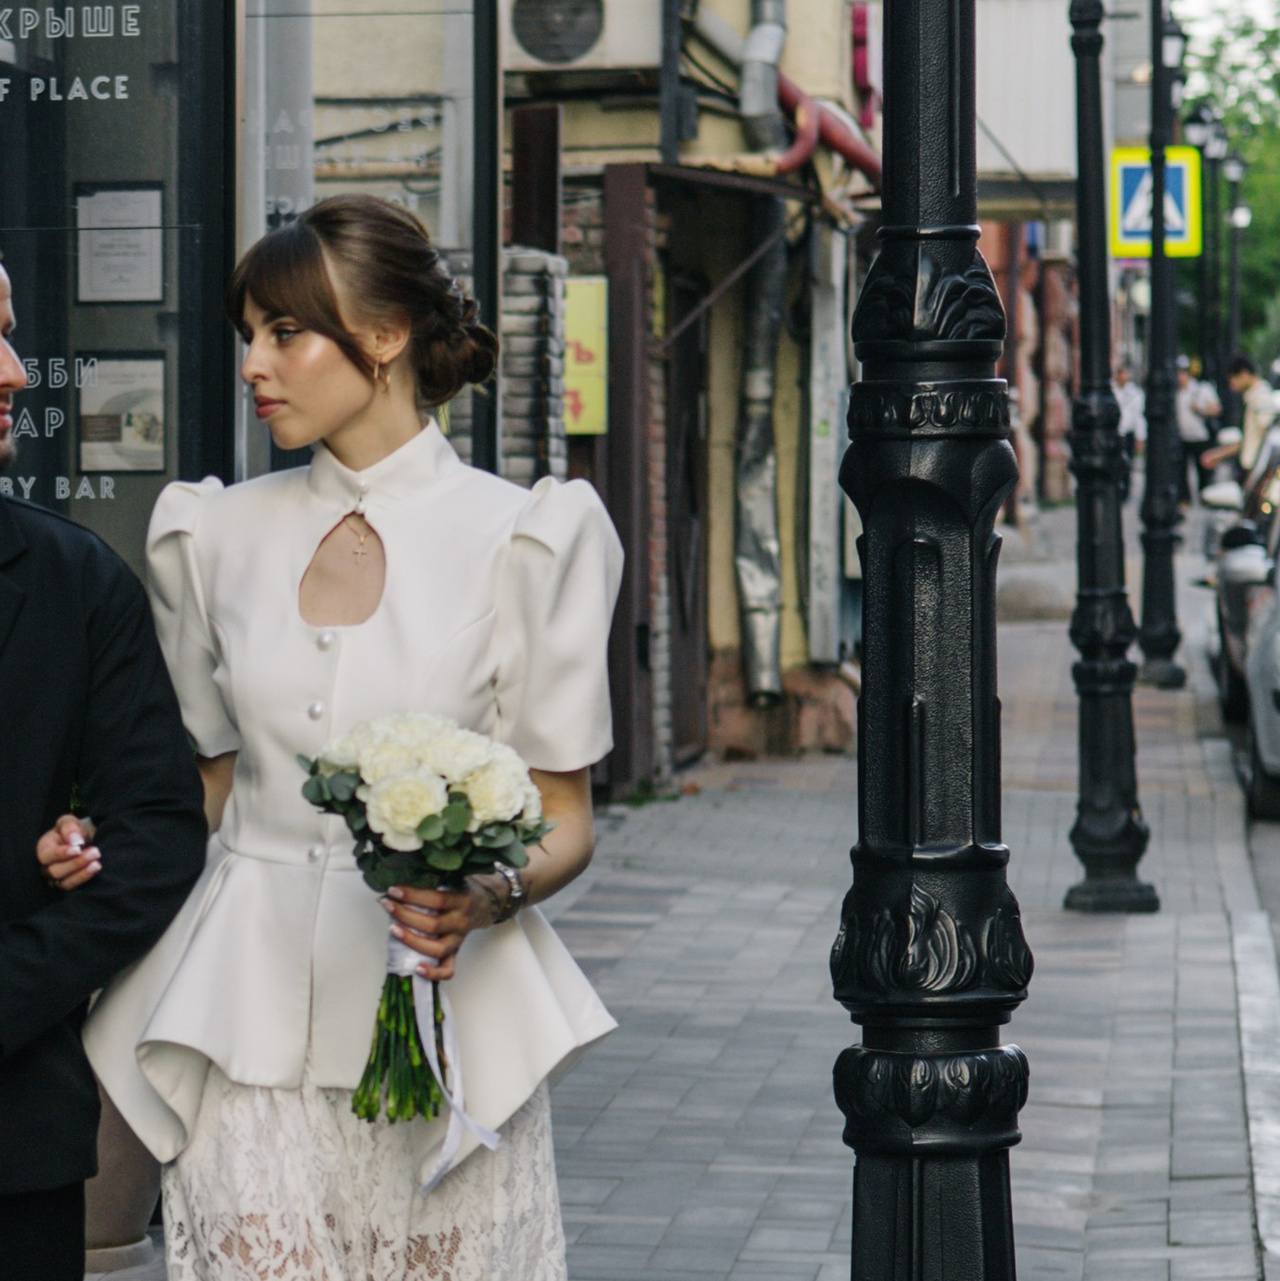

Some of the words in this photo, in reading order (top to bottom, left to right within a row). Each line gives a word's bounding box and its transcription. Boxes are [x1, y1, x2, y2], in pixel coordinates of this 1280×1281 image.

[30, 75, 129, 101] PLACE
[22, 357, 98, 388] ББИ
[12, 406, 65, 438] АР
[55, 476, 115, 500] BAR
